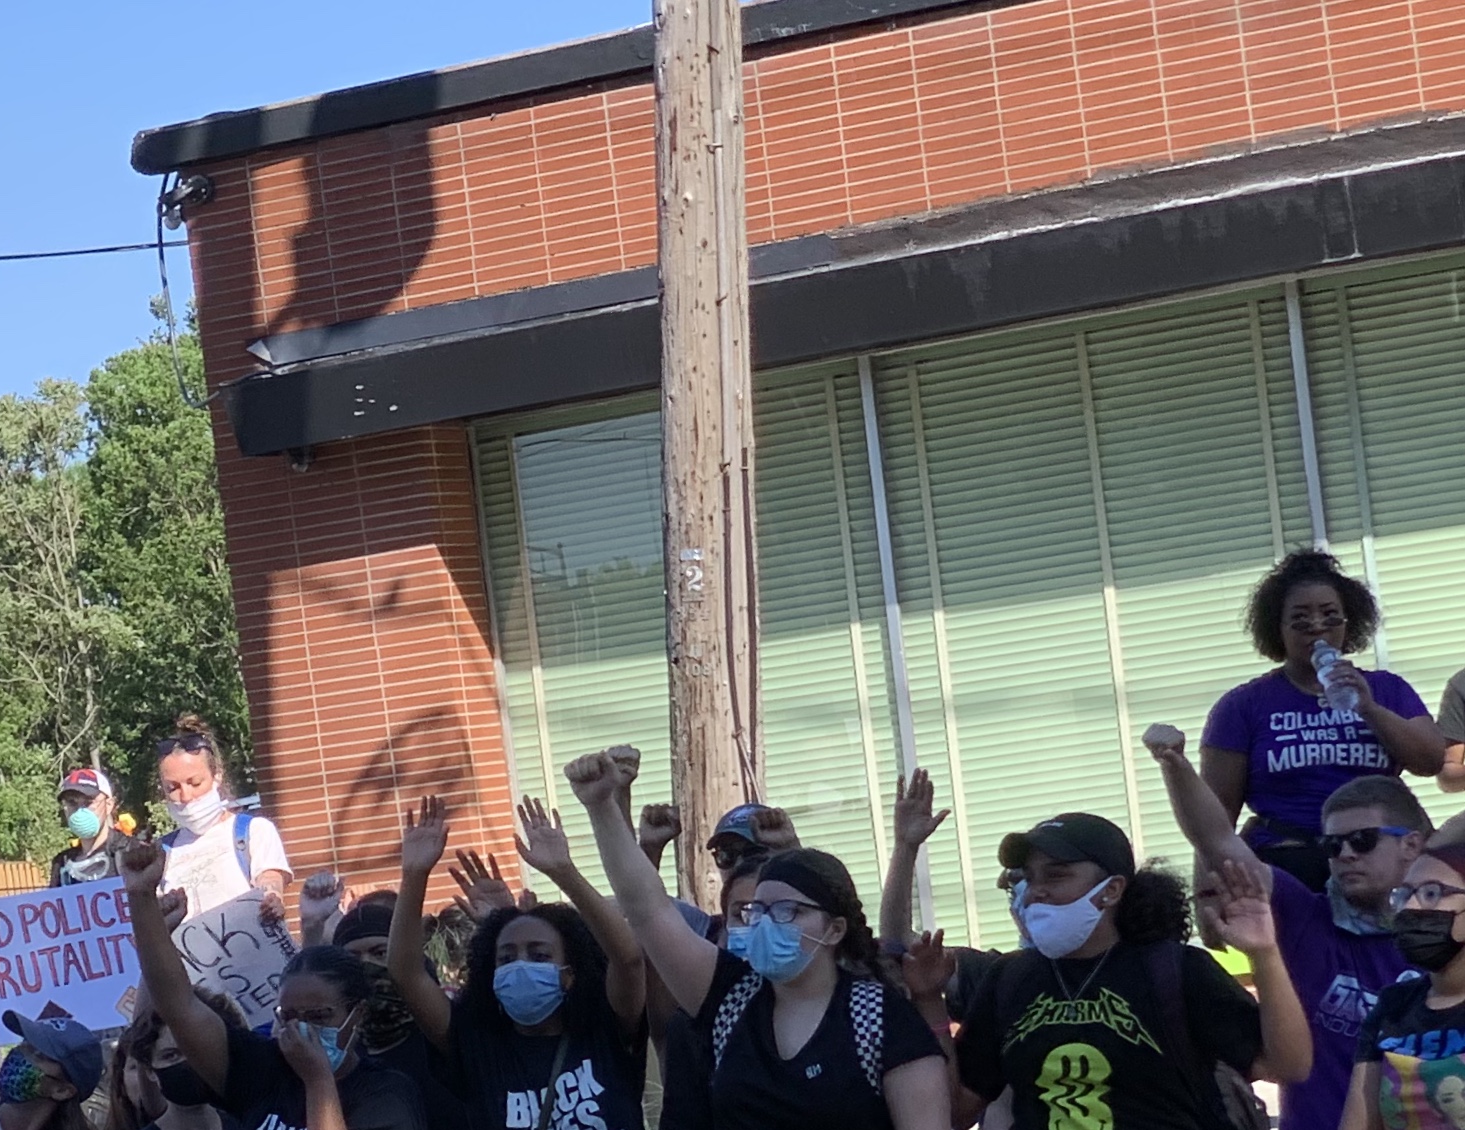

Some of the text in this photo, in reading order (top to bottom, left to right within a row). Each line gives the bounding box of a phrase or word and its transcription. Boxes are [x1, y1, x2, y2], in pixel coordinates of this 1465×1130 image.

[1269, 709, 1365, 731] COLUMB
[1300, 725, 1357, 741] WAS A
[1267, 742, 1390, 773] MURDERER
[18, 888, 133, 944] POLICE
